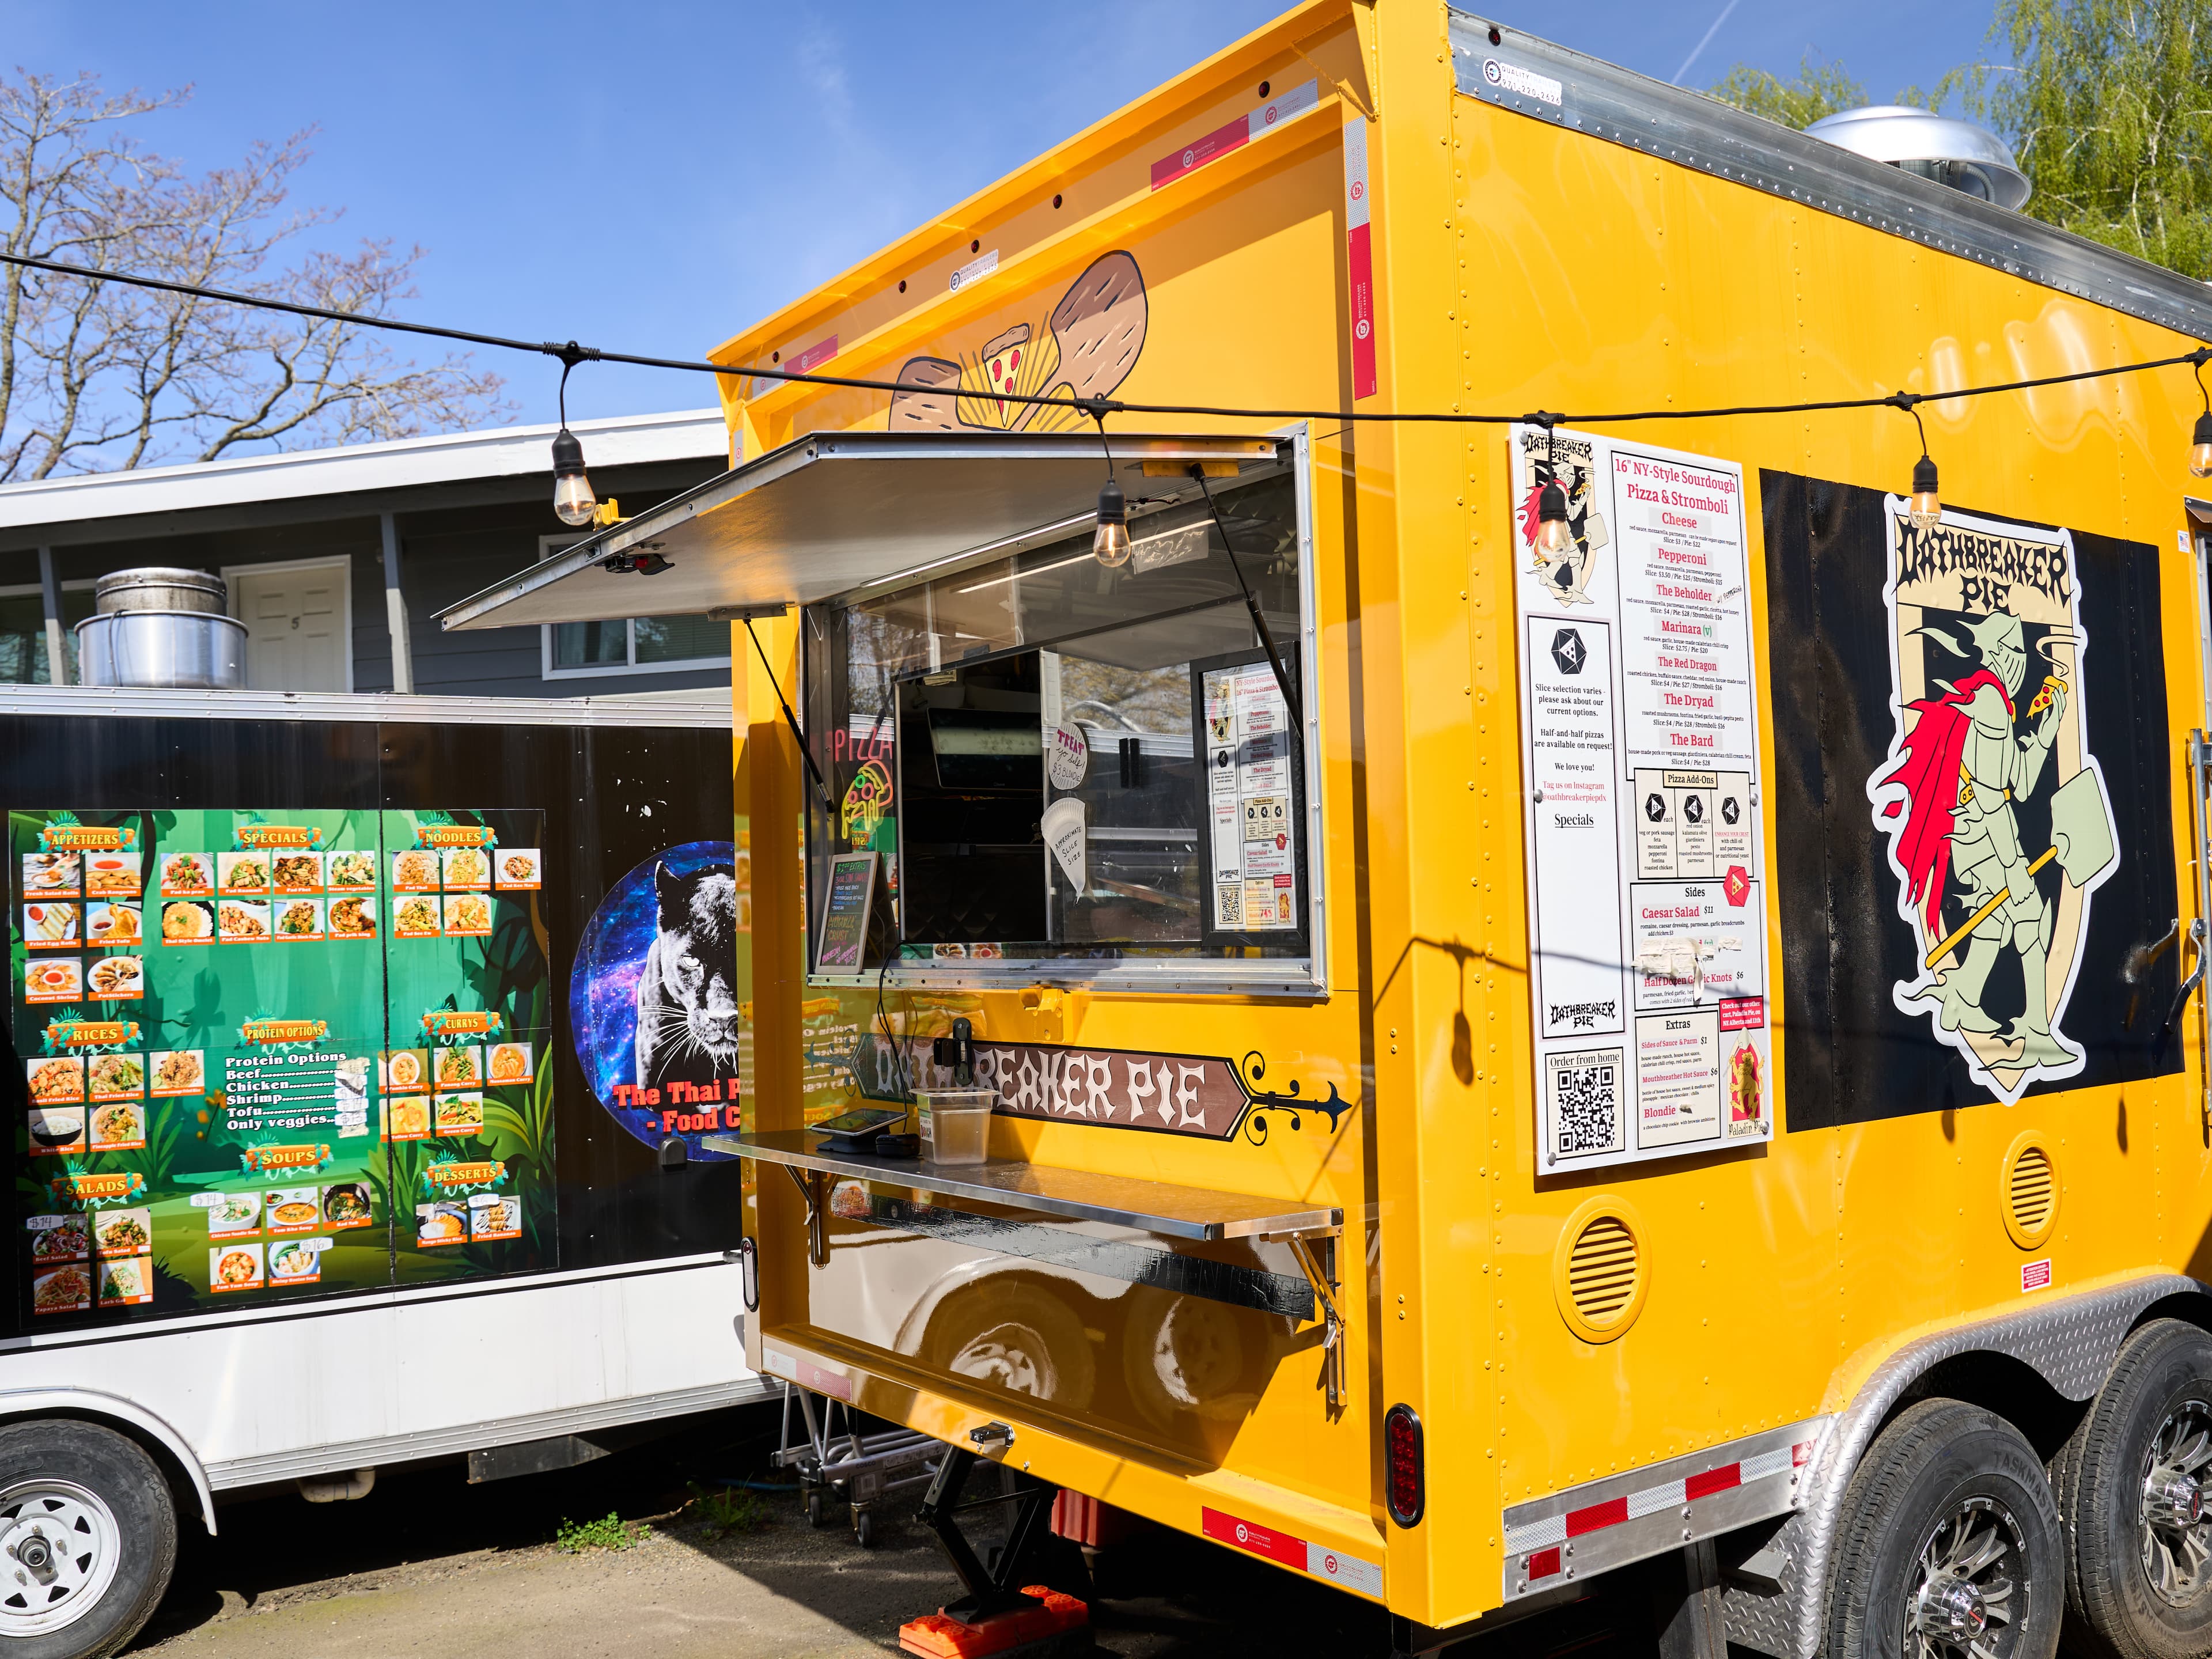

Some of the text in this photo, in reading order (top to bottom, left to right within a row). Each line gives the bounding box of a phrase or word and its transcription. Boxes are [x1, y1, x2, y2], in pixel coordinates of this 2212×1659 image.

[1502, 79, 1560, 104] 971-220-2626
[1615, 459, 1736, 494] 16" NY-Style Sourdough
[1627, 483, 1728, 514] Pizza & Stromboli
[1662, 512, 1697, 528] Cheese
[1658, 548, 1707, 566] Pepperoni
[1891, 506, 2074, 608] OATHBREAKER
[1694, 576, 1714, 584] Stromboli:
[1656, 584, 1712, 601] The Beholder
[1959, 573, 2012, 615] PIE
[291, 616, 300, 630] 5
[1661, 620, 1712, 638] Marinara (v)
[1658, 657, 1717, 672] The Red Dragon
[1535, 683, 1551, 691] Slice
[1552, 685, 1581, 694] selection
[1539, 695, 1559, 704] please
[1573, 697, 1592, 705] about
[1664, 693, 1714, 709] The Dryad
[1573, 709, 1599, 717] options.
[1541, 729, 1604, 740] Half-and-half pizzas
[1670, 733, 1714, 747] The Bard
[835, 729, 893, 762] PIZZA
[1057, 729, 1084, 755] TREAT
[1547, 740, 1575, 748] available
[1586, 743, 1612, 751] request!
[1056, 747, 1069, 761] yo
[1062, 767, 1082, 782] BLONDIES
[1566, 763, 1579, 771] love
[1581, 764, 1594, 772] you!
[1543, 781, 1554, 790] Tag
[1573, 782, 1604, 791] Instagram
[1668, 774, 1714, 784] Pizza Add-Ons
[1555, 813, 1594, 828] Specials
[51, 834, 119, 845] APPETIZERS
[243, 833, 307, 843] SPECIALS
[426, 833, 481, 843] NOODLES
[1055, 826, 1082, 851] APPROXIMATE
[1062, 840, 1077, 858] SLICE
[1067, 851, 1081, 865] SIZE
[1685, 887, 1705, 897] Sides
[1642, 906, 1714, 919] Caesar Salad $11
[1644, 977, 1662, 987] Half
[1663, 976, 1686, 986] Dozen
[1711, 974, 1732, 982] Knots
[1736, 971, 1744, 980] $6
[1548, 998, 1618, 1028] OATHBREAKER
[446, 1018, 478, 1029] CURRYS
[1573, 1015, 1594, 1029] PIE
[1666, 1020, 1691, 1030] Extras
[73, 1029, 118, 1041] RICES
[247, 1025, 324, 1039] PROTEIN OPTIONS
[1700, 1036, 1707, 1045] $1
[225, 1051, 347, 1068] Protein Options
[1550, 1053, 1619, 1067] Order from home
[1642, 1073, 1682, 1083] Mouthbreather
[1710, 1067, 1718, 1077] $6
[612, 1084, 661, 1107] The
[667, 1079, 721, 1105] Thai
[1125, 1059, 1206, 1130] PIE
[1644, 1105, 1676, 1118] Blondie
[226, 1119, 263, 1131] Only
[662, 1108, 718, 1132] Food
[1728, 1120, 1763, 1136] Paladin Pie
[262, 1150, 316, 1165] SOUPS
[434, 1168, 497, 1182] DESSERTS
[66, 1180, 126, 1195] SALADS
[29, 1216, 52, 1228] $14
[1993, 1450, 2061, 1541] TASKMASTER
